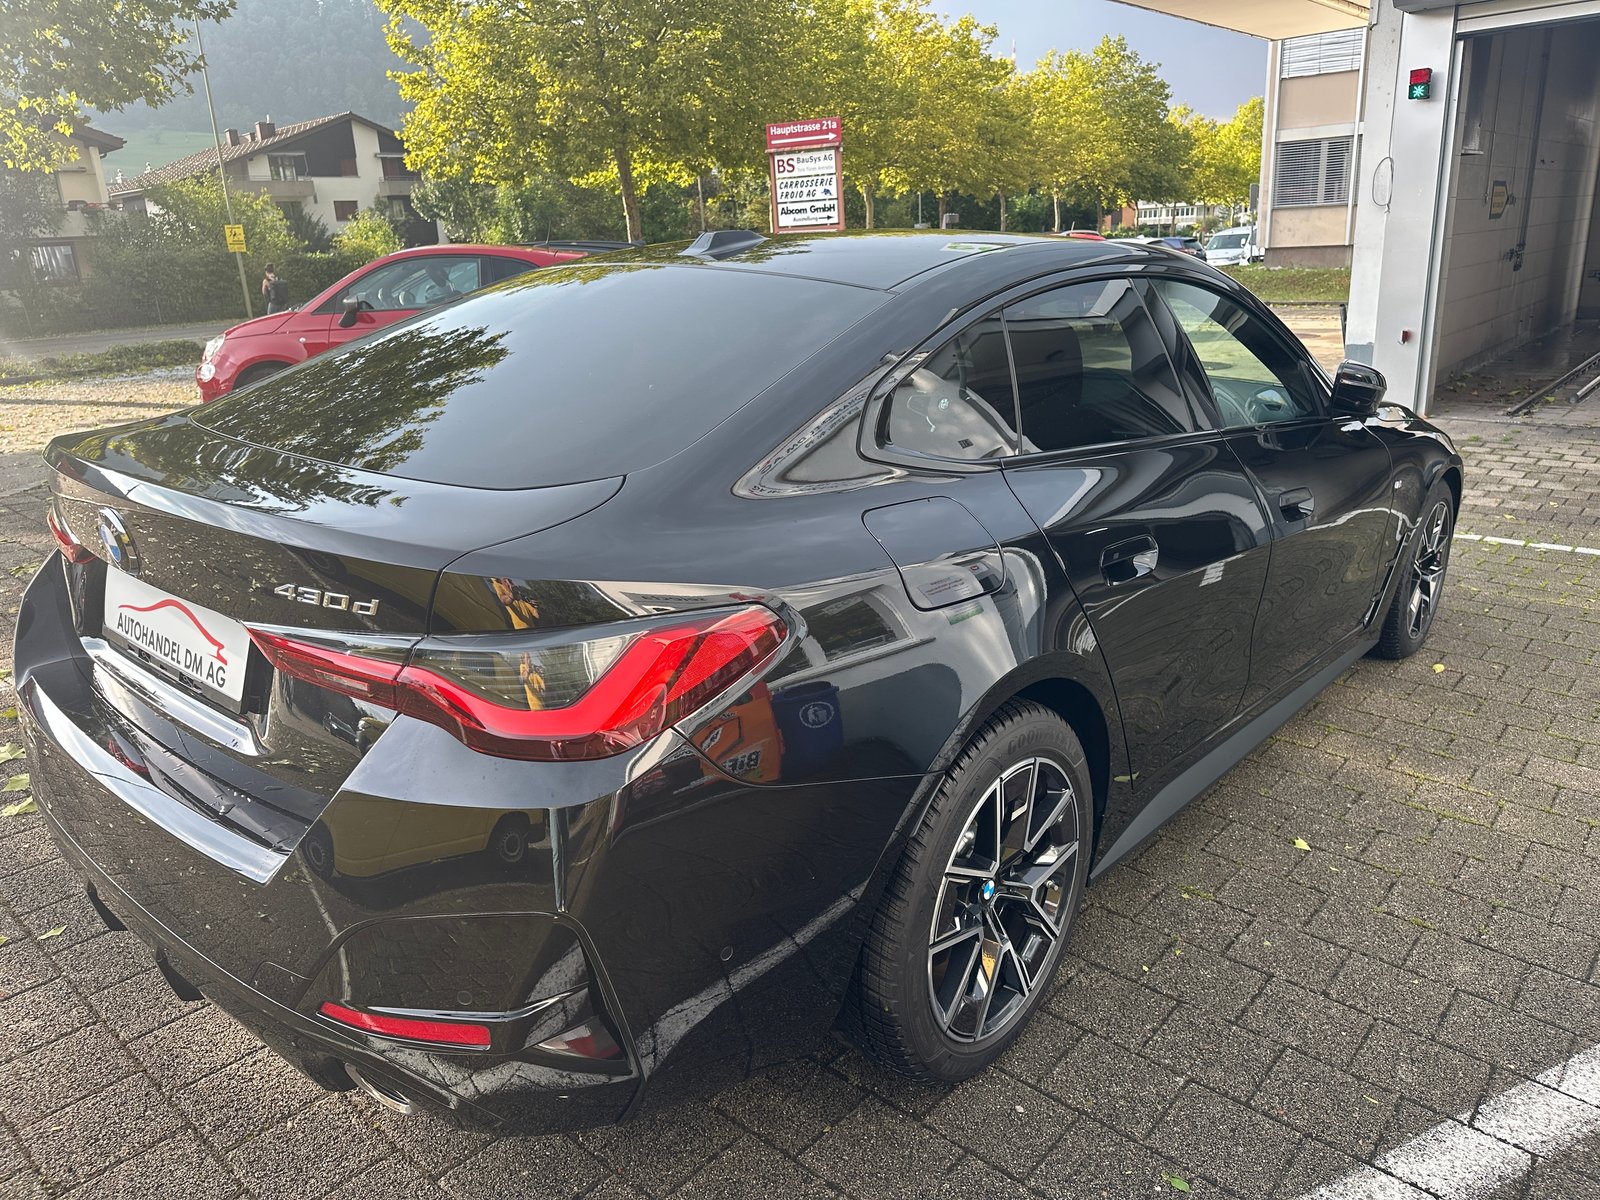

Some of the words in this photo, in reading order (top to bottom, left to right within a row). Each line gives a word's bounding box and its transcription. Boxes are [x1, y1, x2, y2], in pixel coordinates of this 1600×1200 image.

[770, 122, 821, 135] Hauptstrasse
[822, 120, 837, 130] 21a
[777, 158, 796, 173] BS
[796, 156, 822, 165] BauSys
[779, 177, 833, 190] CARROSSERIE
[780, 190, 804, 199] FROIO
[806, 189, 817, 197] AG
[780, 206, 808, 216] Abcom
[810, 203, 836, 213] GmbH
[274, 583, 380, 616] 430d
[117, 612, 181, 665] AUTOHANDEL
[184, 648, 203, 677] DM
[206, 661, 226, 688] AG
